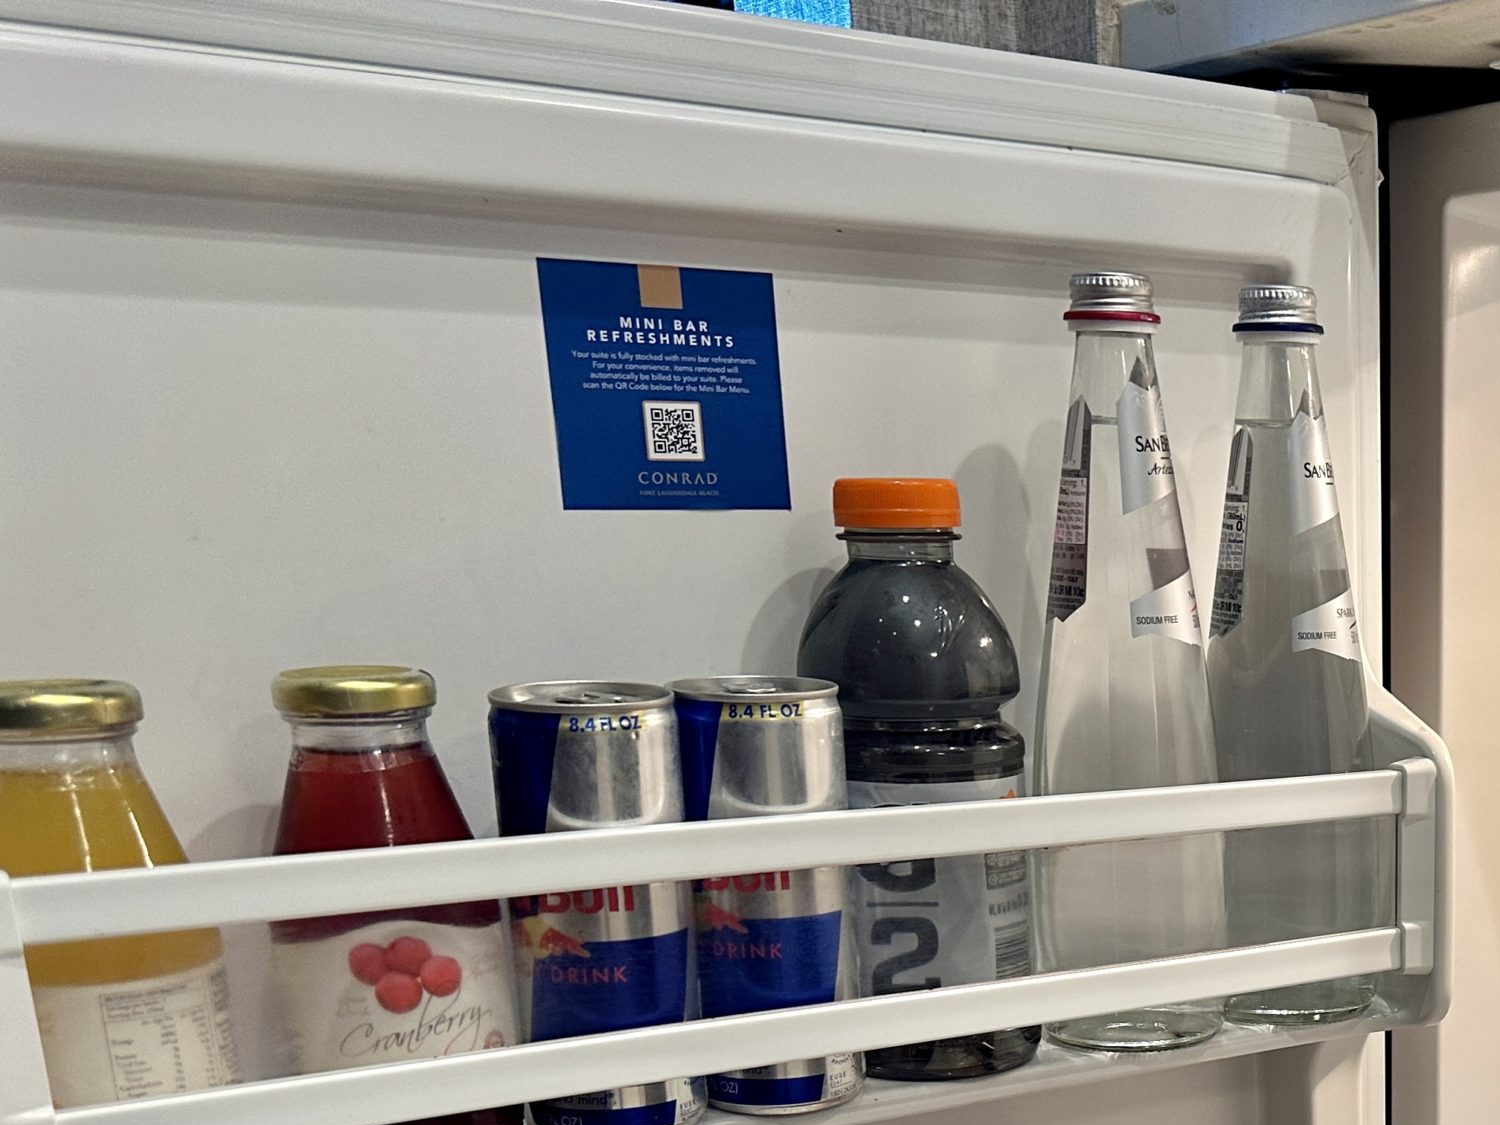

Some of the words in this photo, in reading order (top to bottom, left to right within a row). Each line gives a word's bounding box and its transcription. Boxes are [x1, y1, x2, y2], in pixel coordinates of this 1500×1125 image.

[620, 316, 662, 330] MINI
[674, 320, 708, 332] BAR
[587, 330, 734, 348] REFRESHMENTS
[572, 350, 589, 358] Your
[618, 352, 633, 362] fully
[634, 353, 663, 361] stocked
[681, 354, 696, 362] mini
[590, 372, 638, 381] automatically
[652, 373, 672, 381] billed
[720, 376, 742, 384] Please
[615, 382, 627, 390] QR
[686, 384, 697, 392] the
[638, 472, 718, 484] CONRAD
[1136, 616, 1163, 624] SODIUM
[1164, 615, 1178, 624] FREE
[1297, 631, 1322, 640] SODIUM
[1324, 631, 1337, 639] FREE
[729, 704, 753, 718] 8.4
[760, 704, 776, 718] FL
[780, 703, 802, 717] OZ
[568, 717, 596, 732] 8.4
[600, 716, 616, 731] FL
[619, 715, 641, 730] OZ
[714, 943, 782, 959] DRINK
[551, 966, 627, 984] DRINK
[340, 980, 492, 1057] Cranberry
